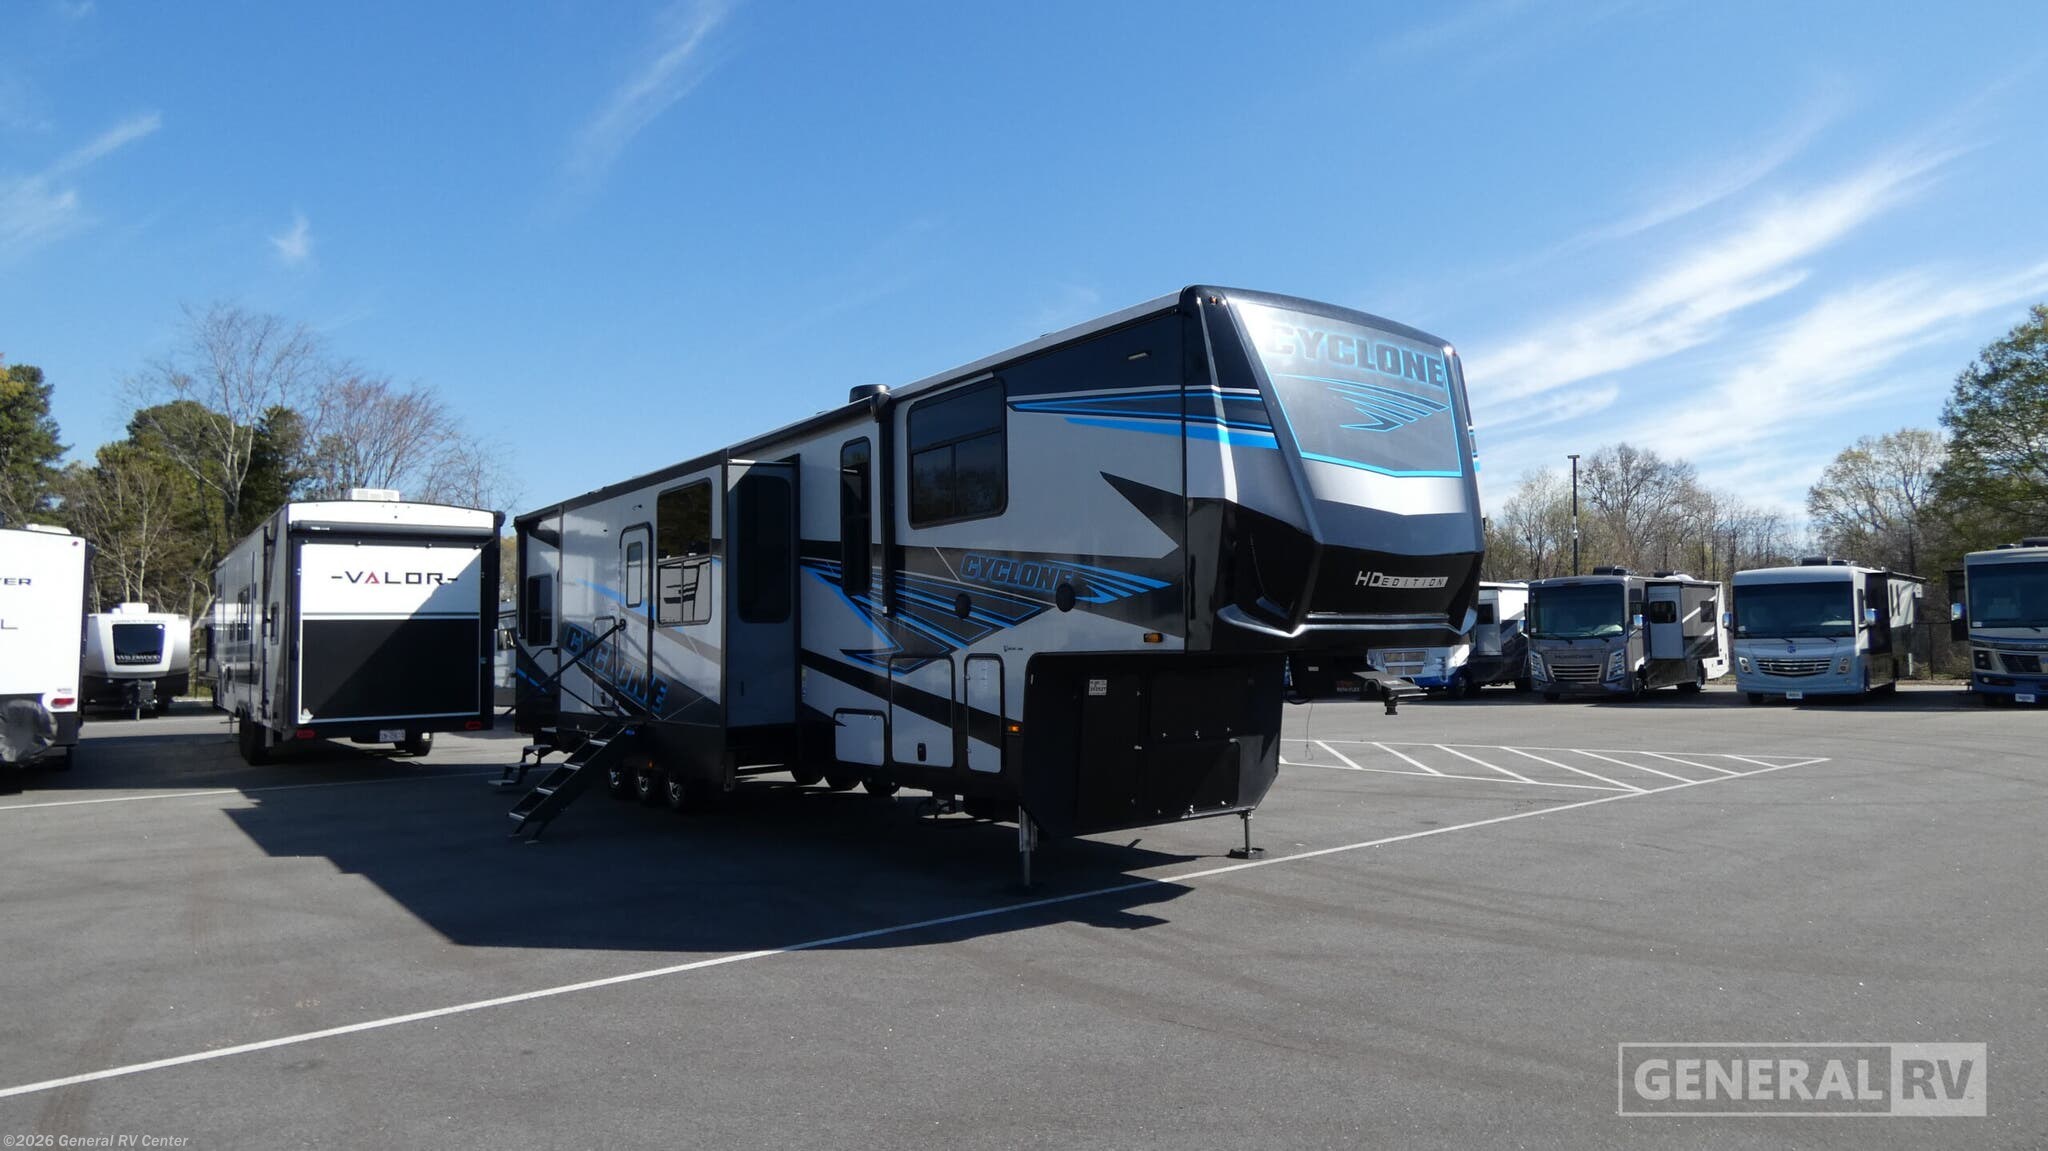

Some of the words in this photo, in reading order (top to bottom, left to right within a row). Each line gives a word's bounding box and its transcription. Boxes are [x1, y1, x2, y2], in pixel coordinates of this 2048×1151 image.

[1266, 322, 1446, 389] CYCLONE
[0, 577, 32, 586] ER
[961, 552, 1075, 594] CYCLONE
[1381, 576, 1447, 589] EDITION
